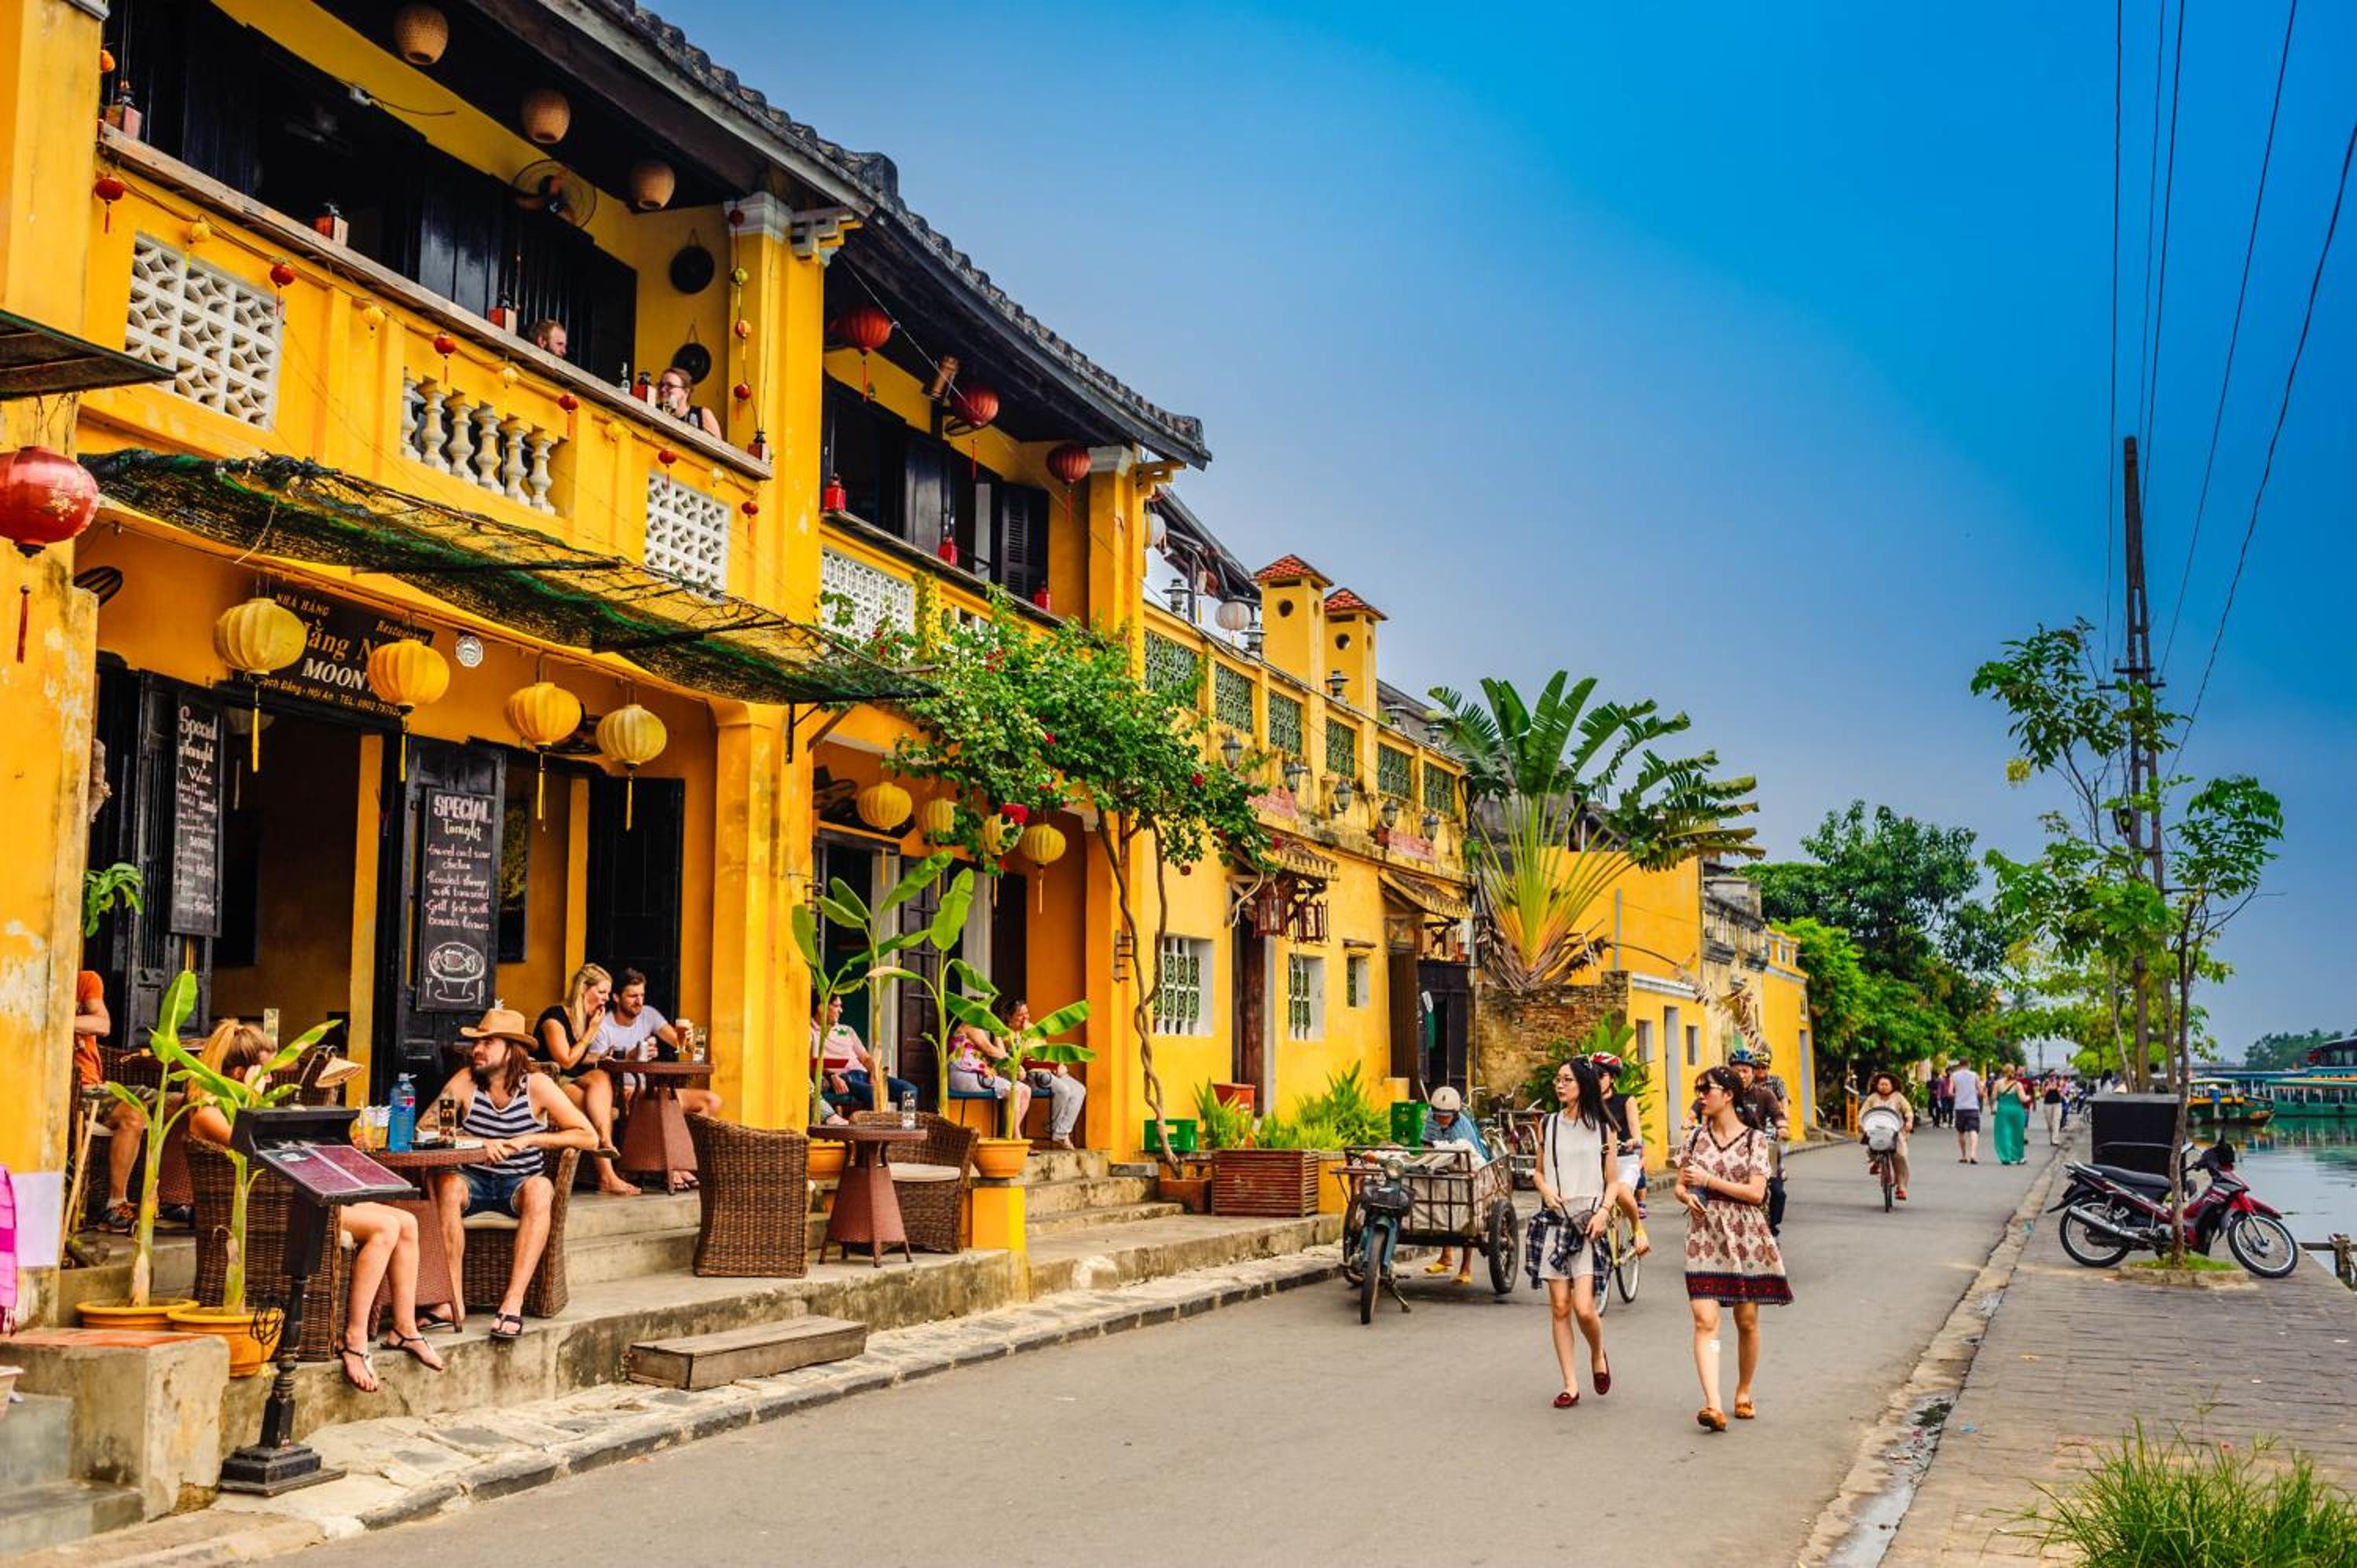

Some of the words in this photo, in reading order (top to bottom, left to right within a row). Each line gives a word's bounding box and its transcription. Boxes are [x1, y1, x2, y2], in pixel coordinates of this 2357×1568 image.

[302, 657, 367, 691] MOON
[433, 794, 493, 824] SPECIAL
[442, 818, 482, 841] Tonight
